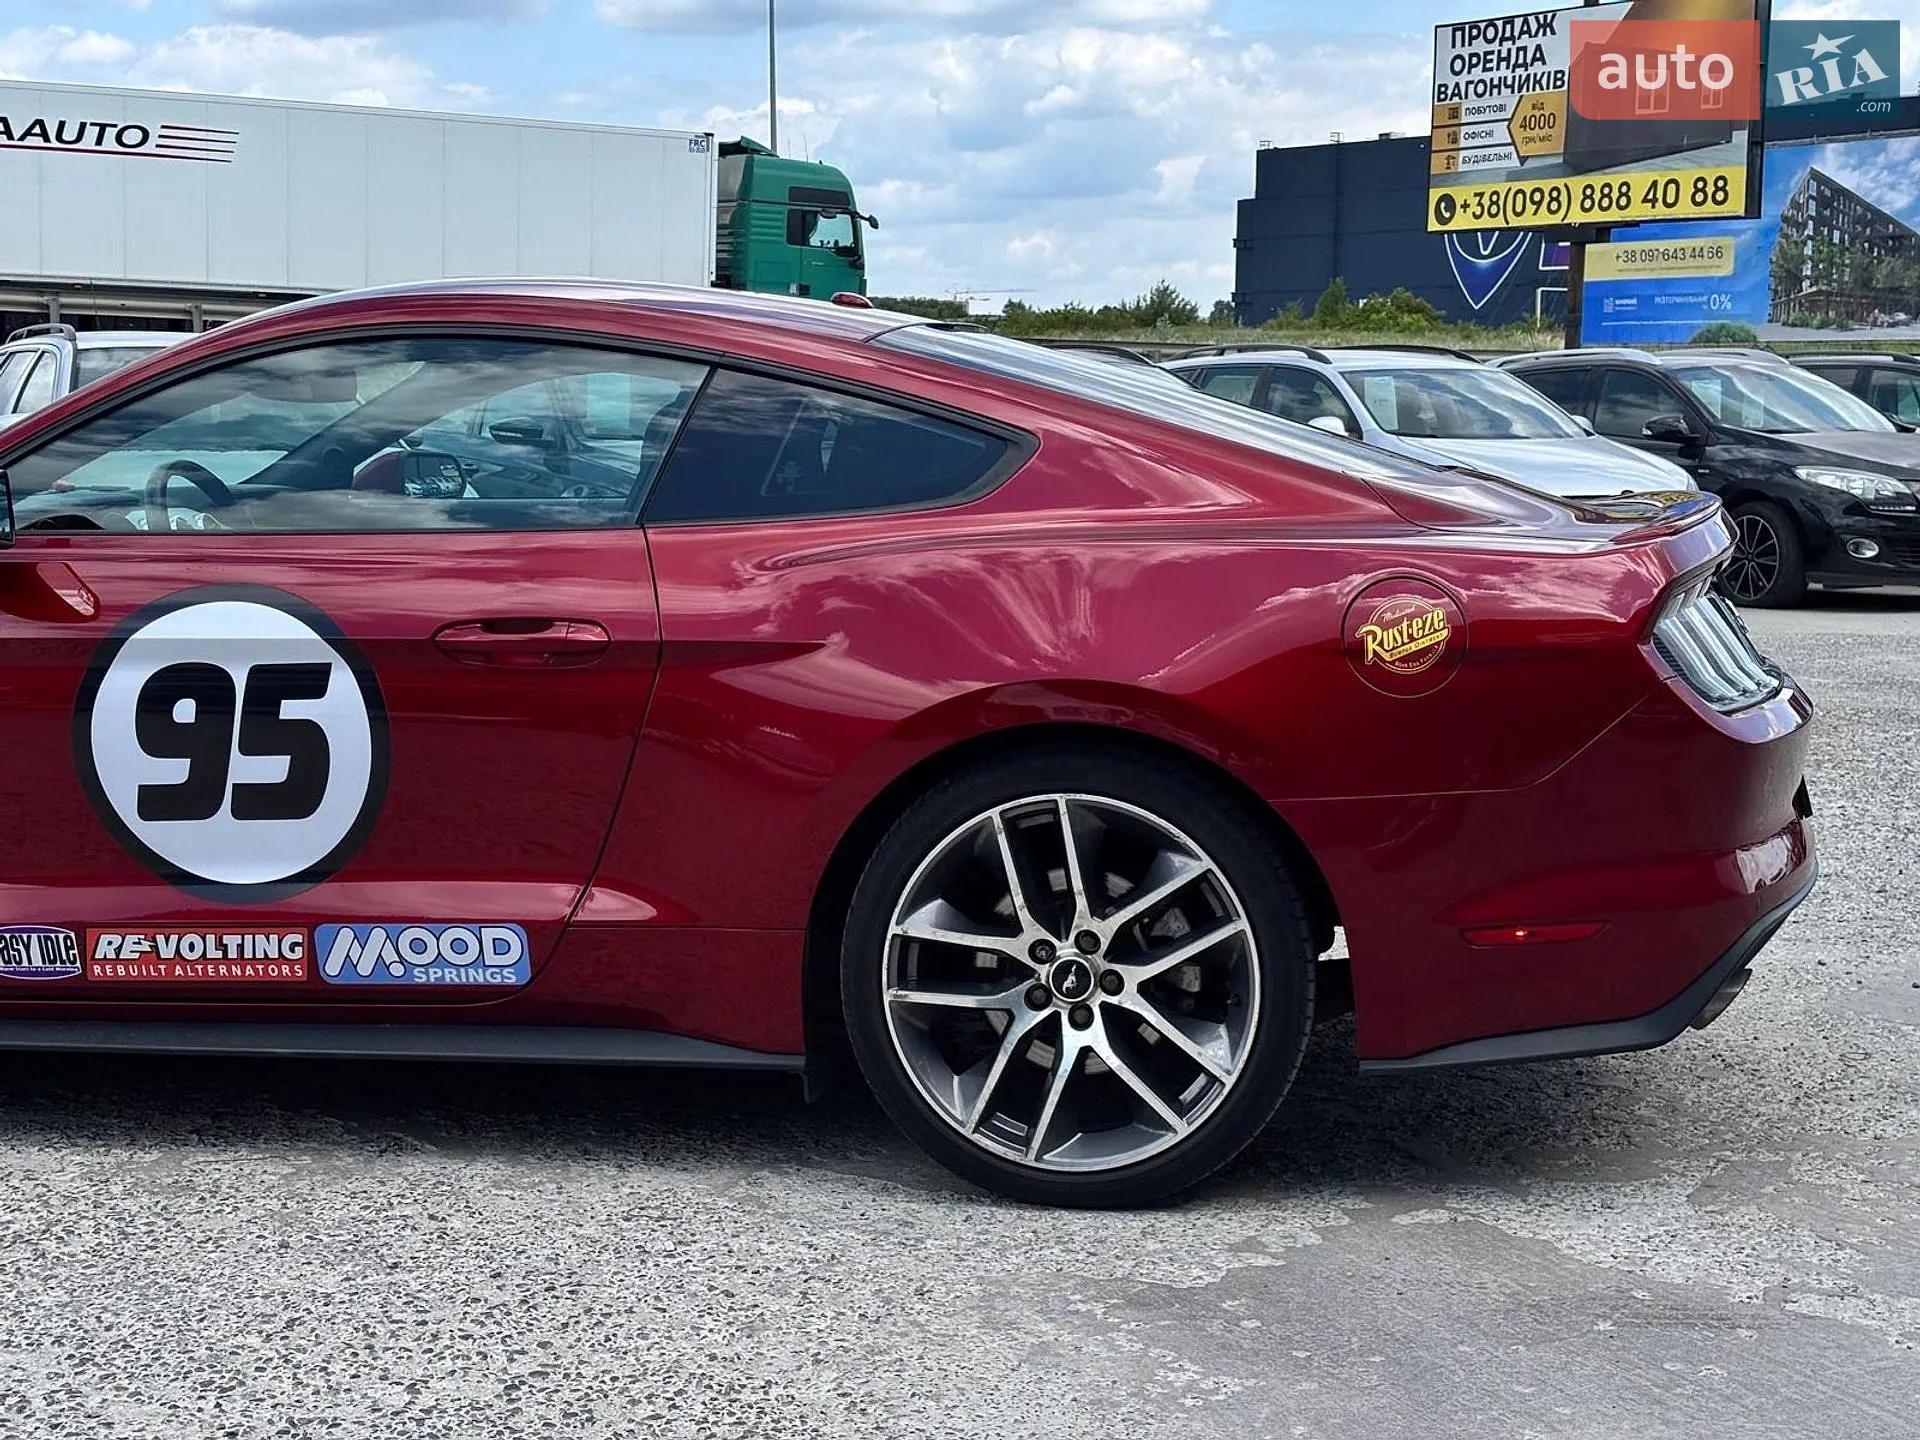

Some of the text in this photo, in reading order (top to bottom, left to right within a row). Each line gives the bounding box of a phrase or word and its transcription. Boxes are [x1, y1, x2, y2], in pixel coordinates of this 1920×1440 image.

[1450, 12, 1557, 49] ПРОДАЖ
[1449, 43, 1547, 76] ОРЕНДА
[1436, 69, 1566, 103] ВАГОНЧИКІВ
[1464, 103, 1508, 117] ПОБУТОВІ
[1519, 112, 1557, 132] 4000
[1462, 129, 1495, 141] ОФІСНІ
[1461, 151, 1513, 165] БУДІВЕЛЬНІ
[1459, 175, 1729, 225] +38(098) 888 40 88
[1710, 293, 1732, 311] 0%
[135, 661, 333, 822] 95
[323, 926, 523, 978] MOOD
[93, 964, 304, 977] REBUILT ALTERNATORS
[413, 967, 517, 983] SPRINGS
